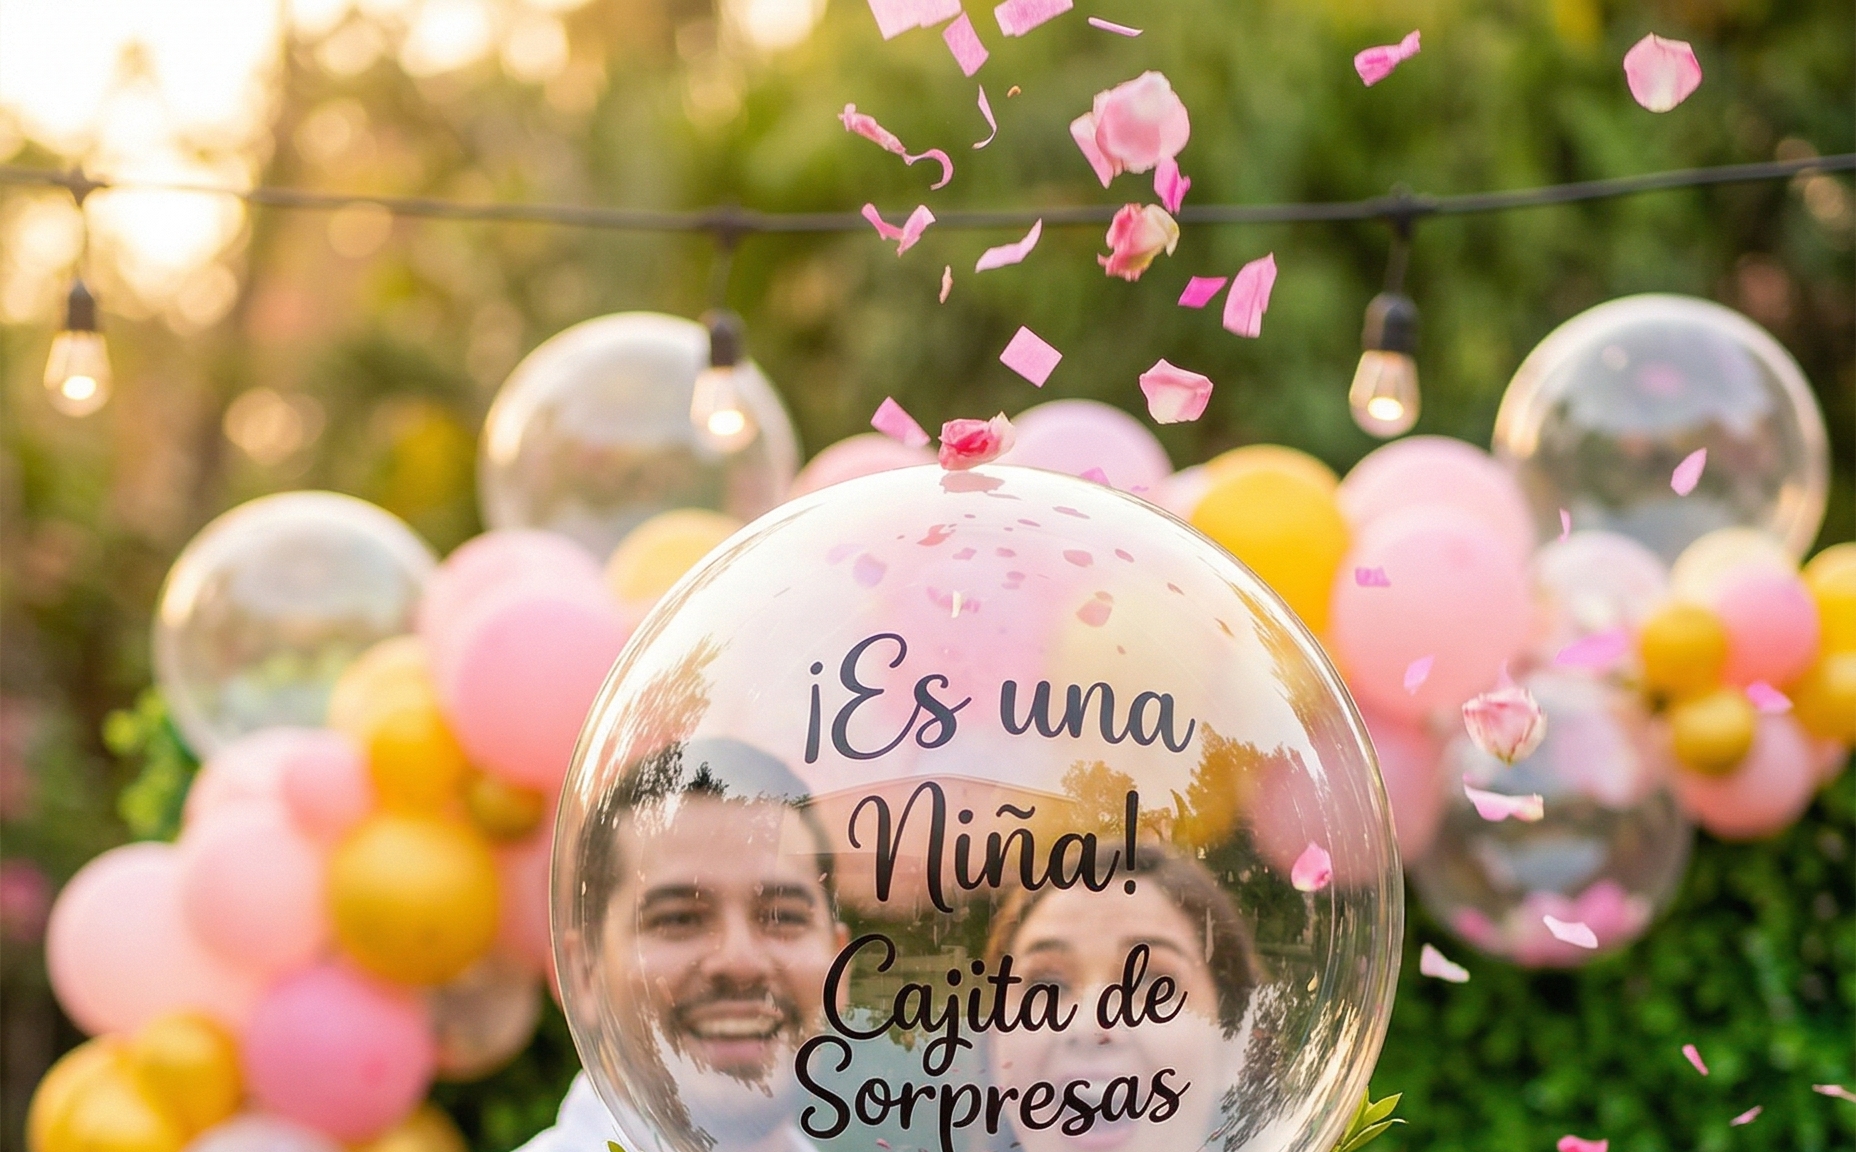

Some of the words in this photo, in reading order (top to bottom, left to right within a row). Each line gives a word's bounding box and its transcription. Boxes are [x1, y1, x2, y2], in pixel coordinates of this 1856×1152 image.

[804, 632, 972, 764] ¡Es
[1000, 679, 1196, 753] una
[848, 781, 1138, 913] Niña!
[822, 933, 1078, 1077] Cajita
[1096, 943, 1188, 1028] de
